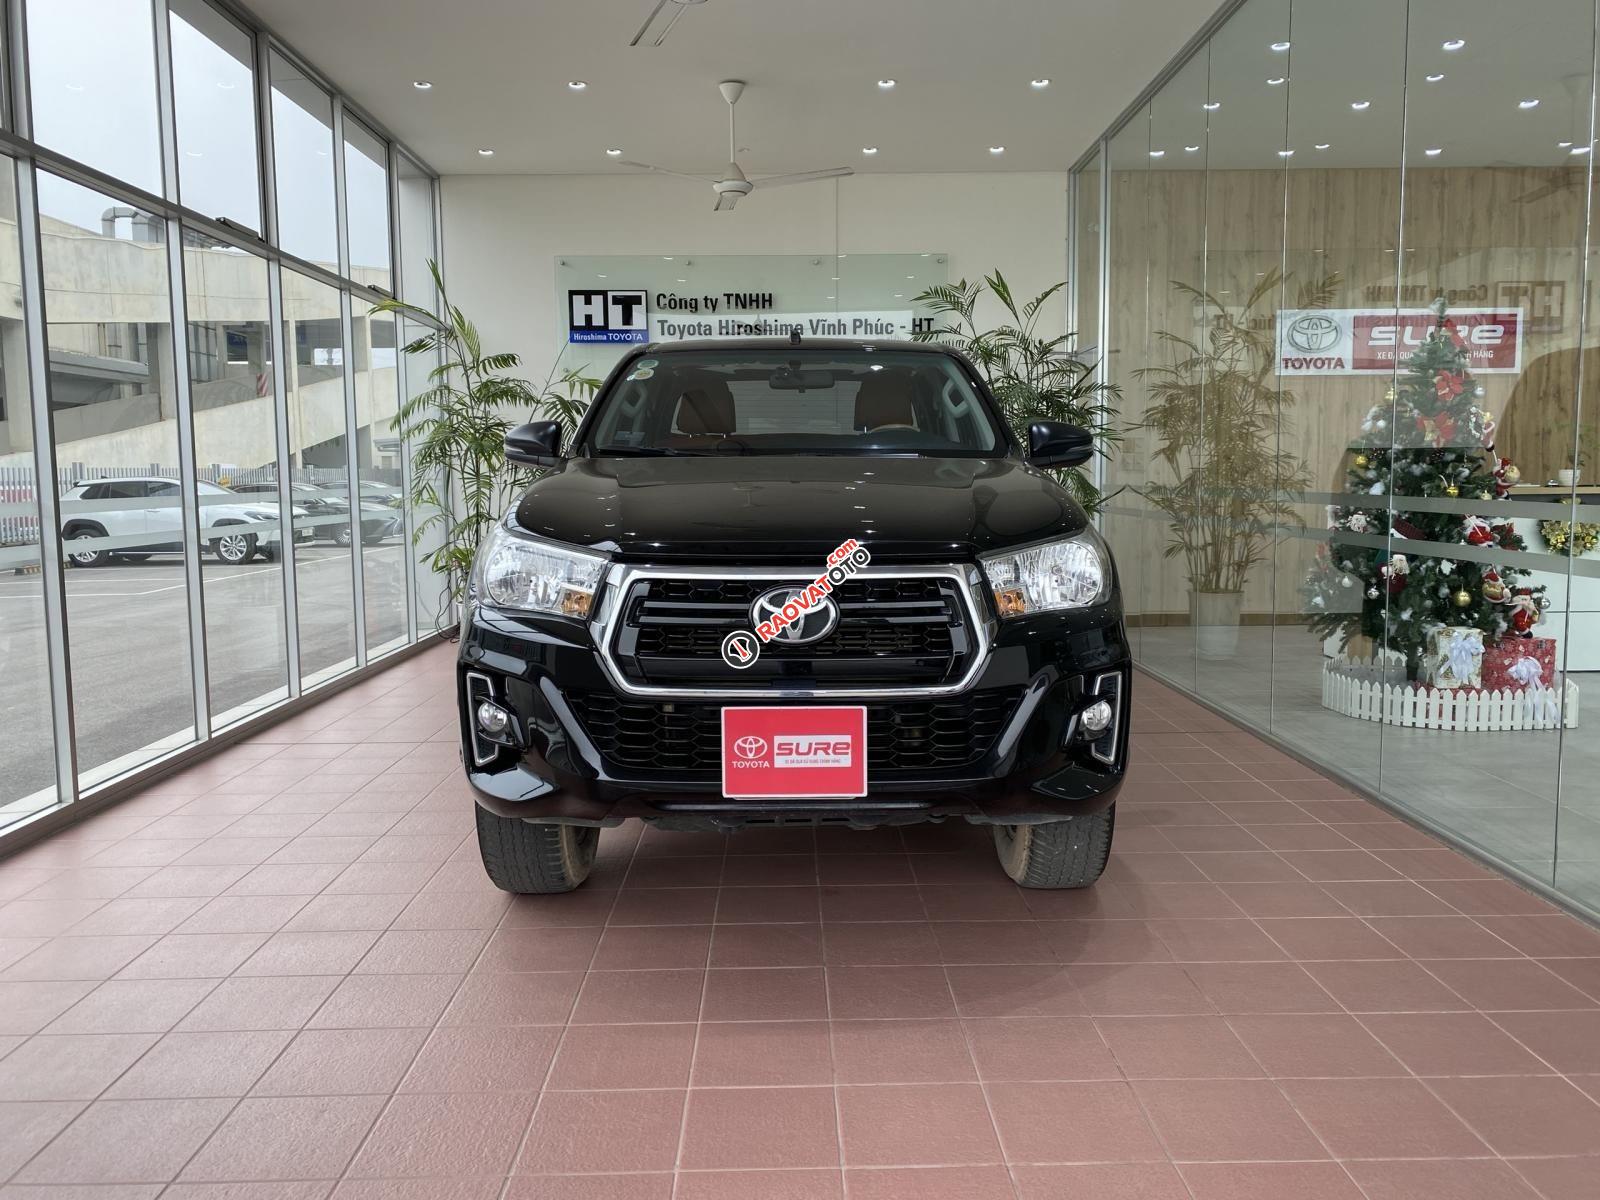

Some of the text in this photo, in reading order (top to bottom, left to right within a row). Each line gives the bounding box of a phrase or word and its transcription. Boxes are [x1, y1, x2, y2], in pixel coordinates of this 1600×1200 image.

[572, 294, 643, 326] HT
[656, 293, 773, 313] Công ty TNHH
[657, 319, 713, 339] Toyota
[718, 318, 804, 336] Hiroshima
[808, 318, 847, 336] Vĩnh
[852, 318, 894, 335] Phúc
[911, 318, 935, 335] HT
[573, 333, 643, 341] Hiroshima TOYOTA
[1281, 357, 1346, 370] TOYOTA
[732, 761, 770, 769] TOYOTA
